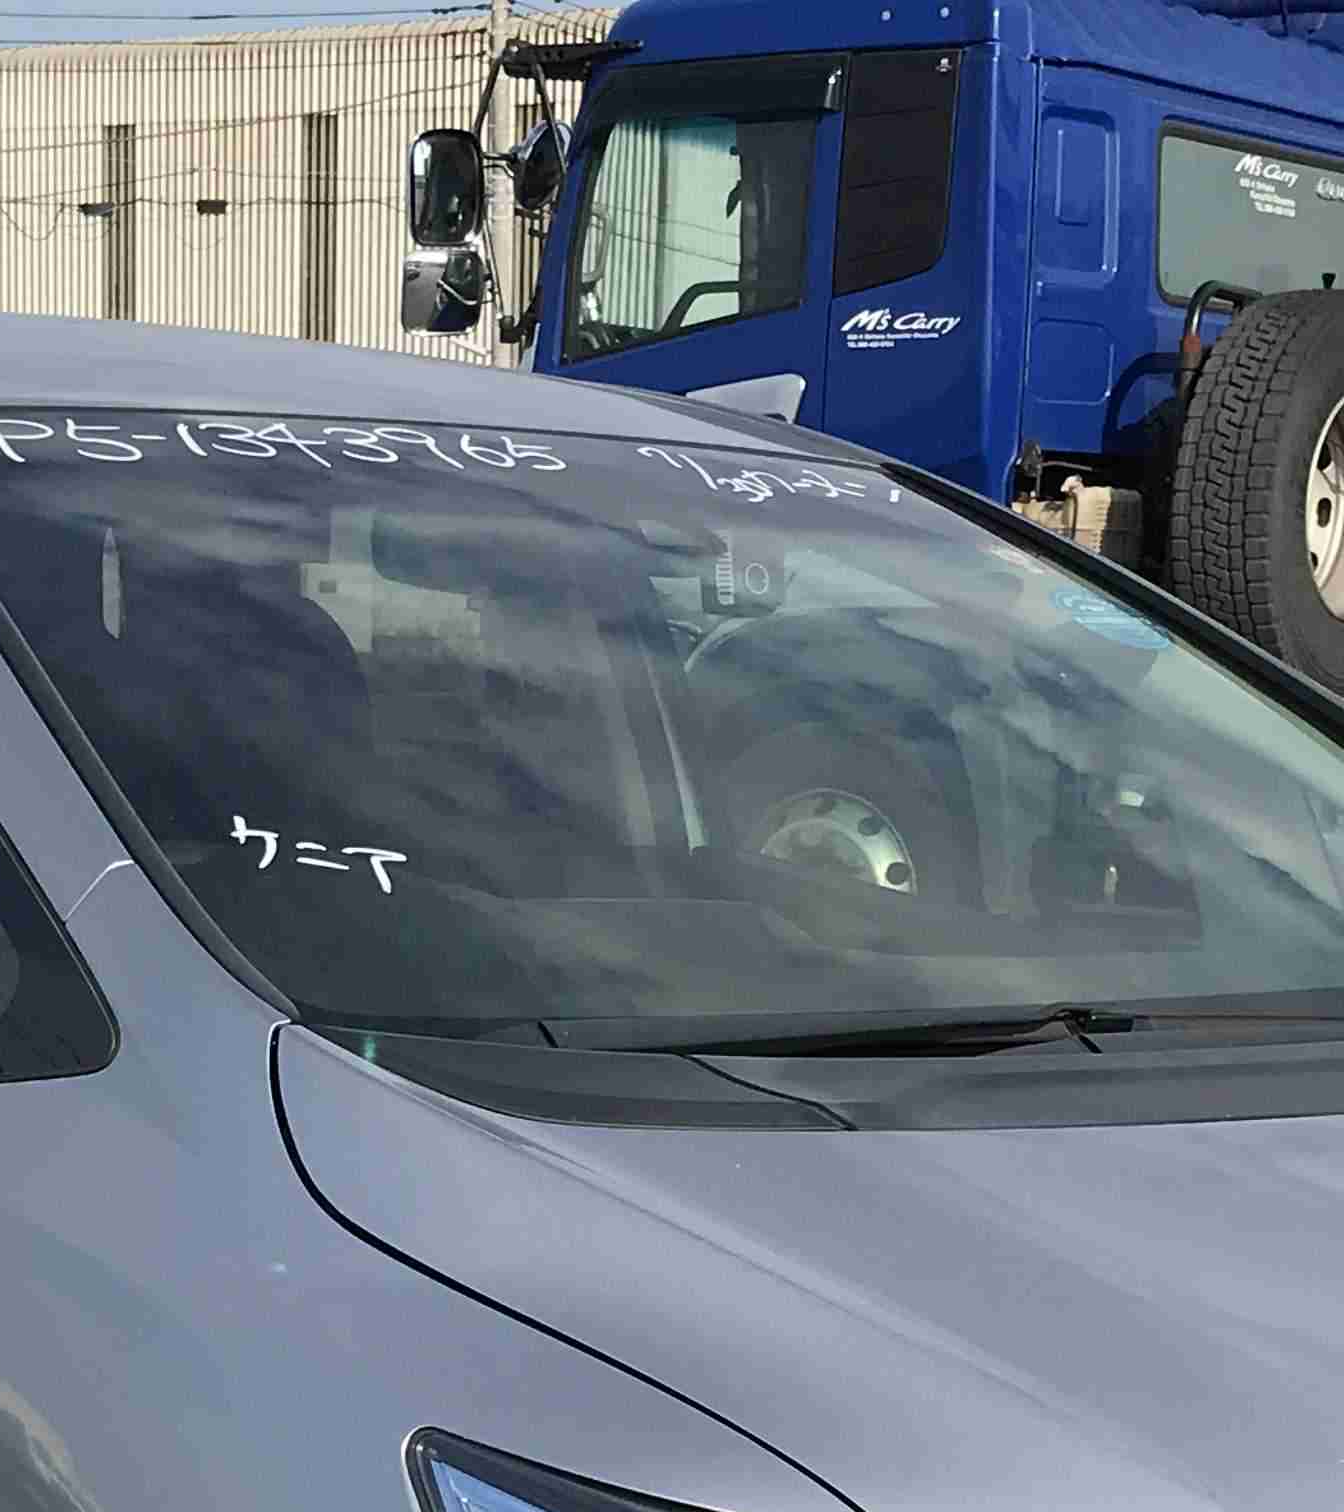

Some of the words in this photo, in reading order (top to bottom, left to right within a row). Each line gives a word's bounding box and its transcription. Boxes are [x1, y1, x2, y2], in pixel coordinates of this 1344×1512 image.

[1262, 163, 1300, 188] Carry
[840, 307, 893, 332] M's
[892, 312, 961, 335] Carry
